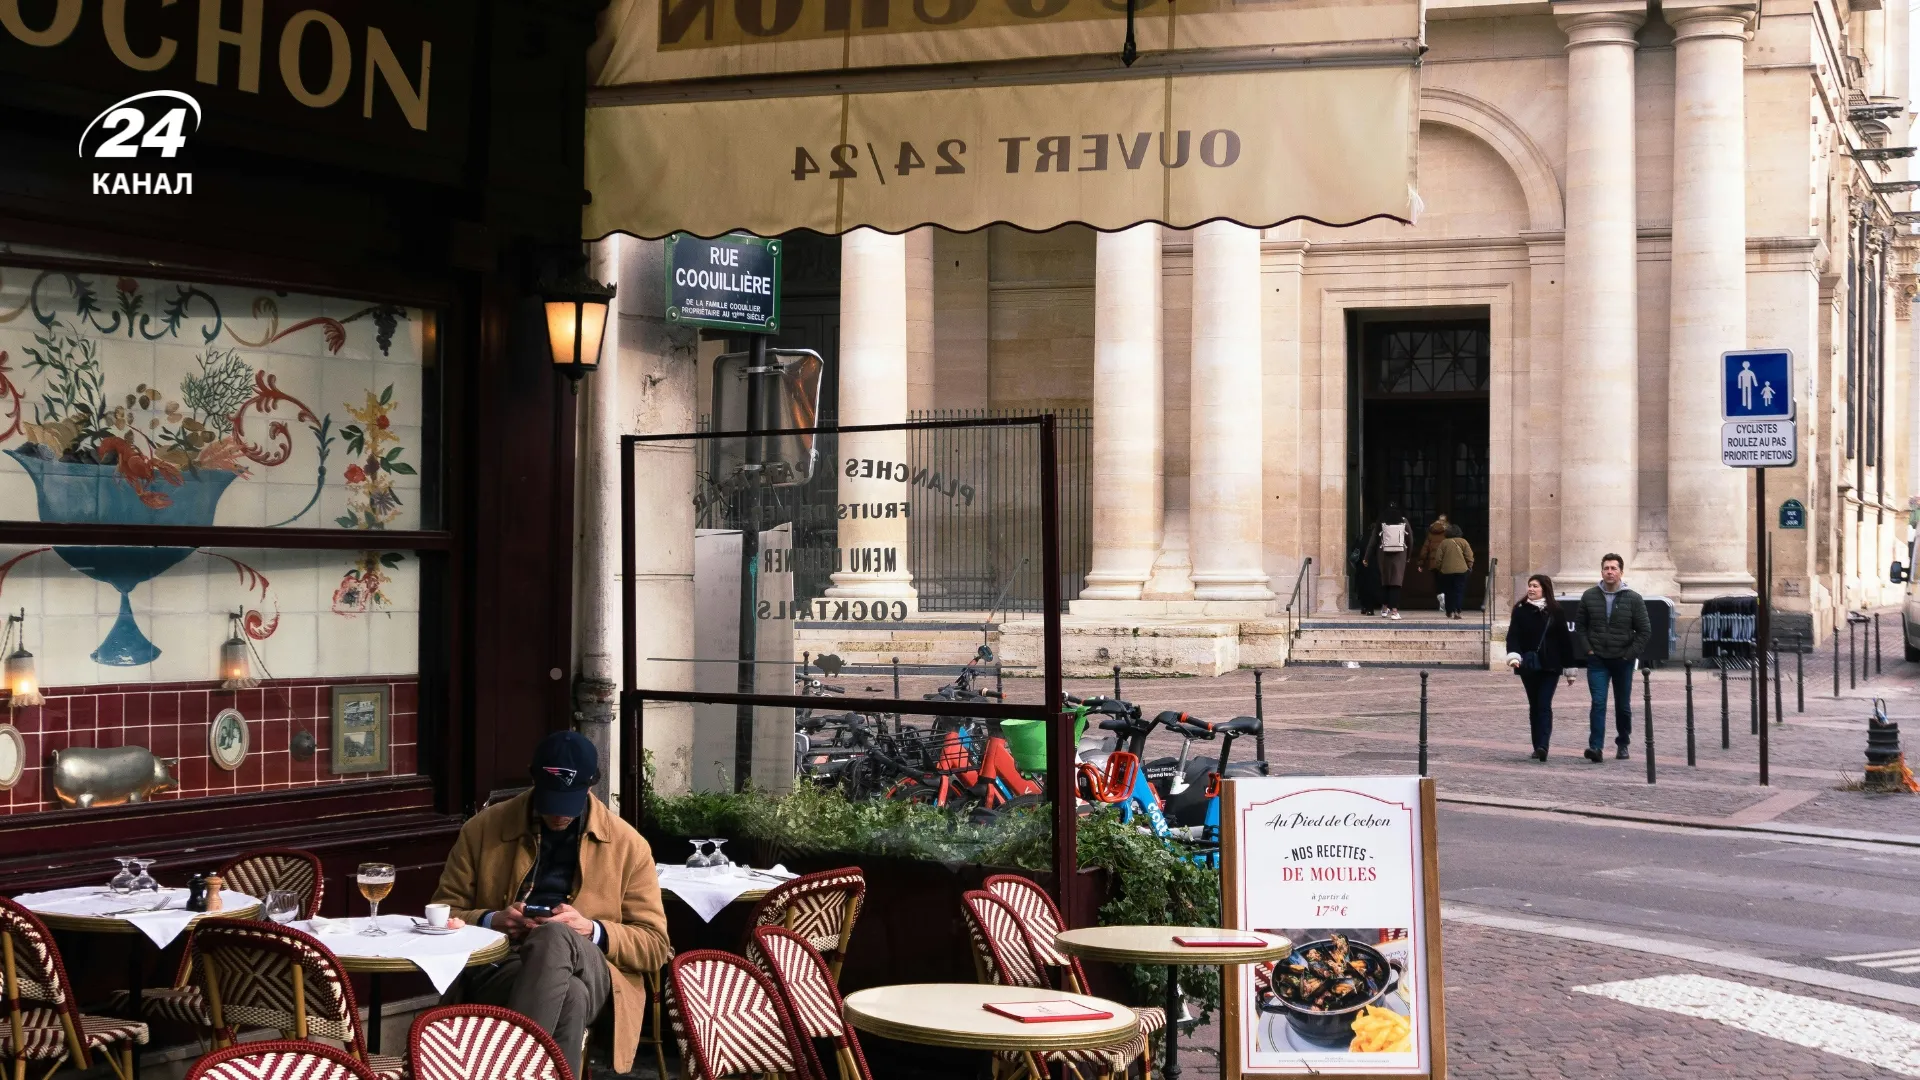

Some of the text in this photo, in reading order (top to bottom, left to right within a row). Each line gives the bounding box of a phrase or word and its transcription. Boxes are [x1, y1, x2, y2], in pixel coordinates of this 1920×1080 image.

[710, 246, 739, 267] RUE
[675, 267, 771, 295] COQUILLIÈRE
[682, 306, 720, 316] PROPRIÉTAIRE
[746, 312, 764, 321] SIÈCLE
[706, 300, 728, 309] FAMILLE
[730, 302, 760, 312] COQUILLIER
[1736, 424, 1778, 434] CYCLISTES
[1728, 436, 1786, 447] ROULEZ AU PAS
[1724, 450, 1792, 460] PRIORITE PIETONS
[1264, 811, 1392, 831] Au Pied de Cochon
[1291, 844, 1367, 862] NOS RECETTES
[1282, 867, 1377, 882] DE MOULES
[1318, 893, 1339, 901] partir
